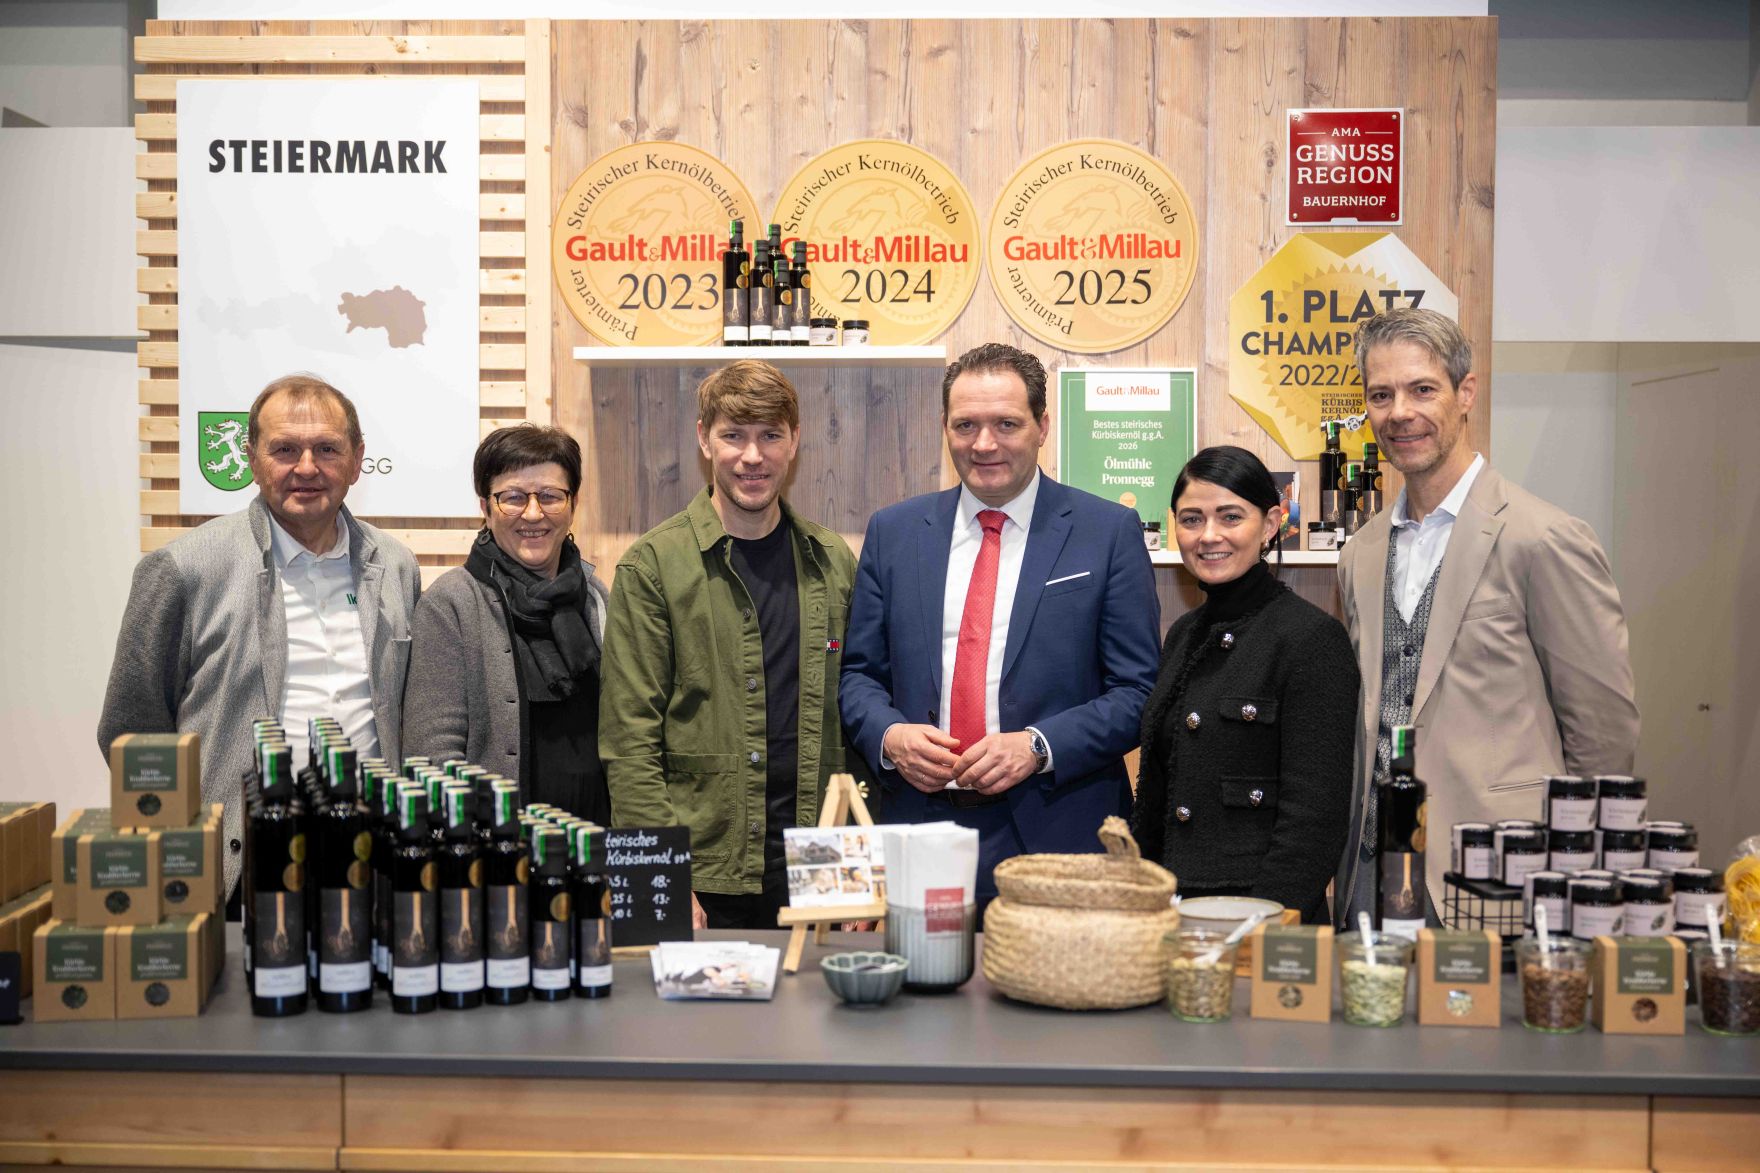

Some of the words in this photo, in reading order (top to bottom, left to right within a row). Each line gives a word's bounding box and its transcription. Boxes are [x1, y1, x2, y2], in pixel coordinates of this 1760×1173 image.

[1331, 127, 1361, 137] AMA
[208, 139, 448, 174] STEIERMARK
[1296, 143, 1394, 162] GENUSS
[1297, 166, 1393, 184] REGION
[567, 160, 639, 230] Steirischer
[783, 161, 852, 234] Steirischer
[857, 154, 960, 225] Kernölbetrieb
[1003, 160, 1074, 229] Steirischer
[1080, 154, 1178, 225] Kernölbetrieb
[1303, 195, 1387, 207] BAUERNHOF
[1003, 233, 1181, 261] Gault&Millau
[617, 273, 720, 310] 2023
[840, 268, 936, 304] 2024
[1053, 268, 1152, 306] 2025
[570, 268, 639, 341] Prämierter
[1007, 267, 1074, 335] Prämierter
[1260, 289, 1289, 323] 1.
[1321, 398, 1363, 407] KÜRBIS
[1091, 430, 1140, 440] Kürbiskernöl
[1142, 431, 1164, 441] g.g.A.
[1093, 420, 1120, 429] Bestes
[1120, 420, 1163, 429] steirisches
[1118, 441, 1138, 450] 2026
[1104, 456, 1153, 470] Ölmühle
[1102, 473, 1155, 487] Pronnegg
[605, 847, 672, 866] Kürbiskernöl
